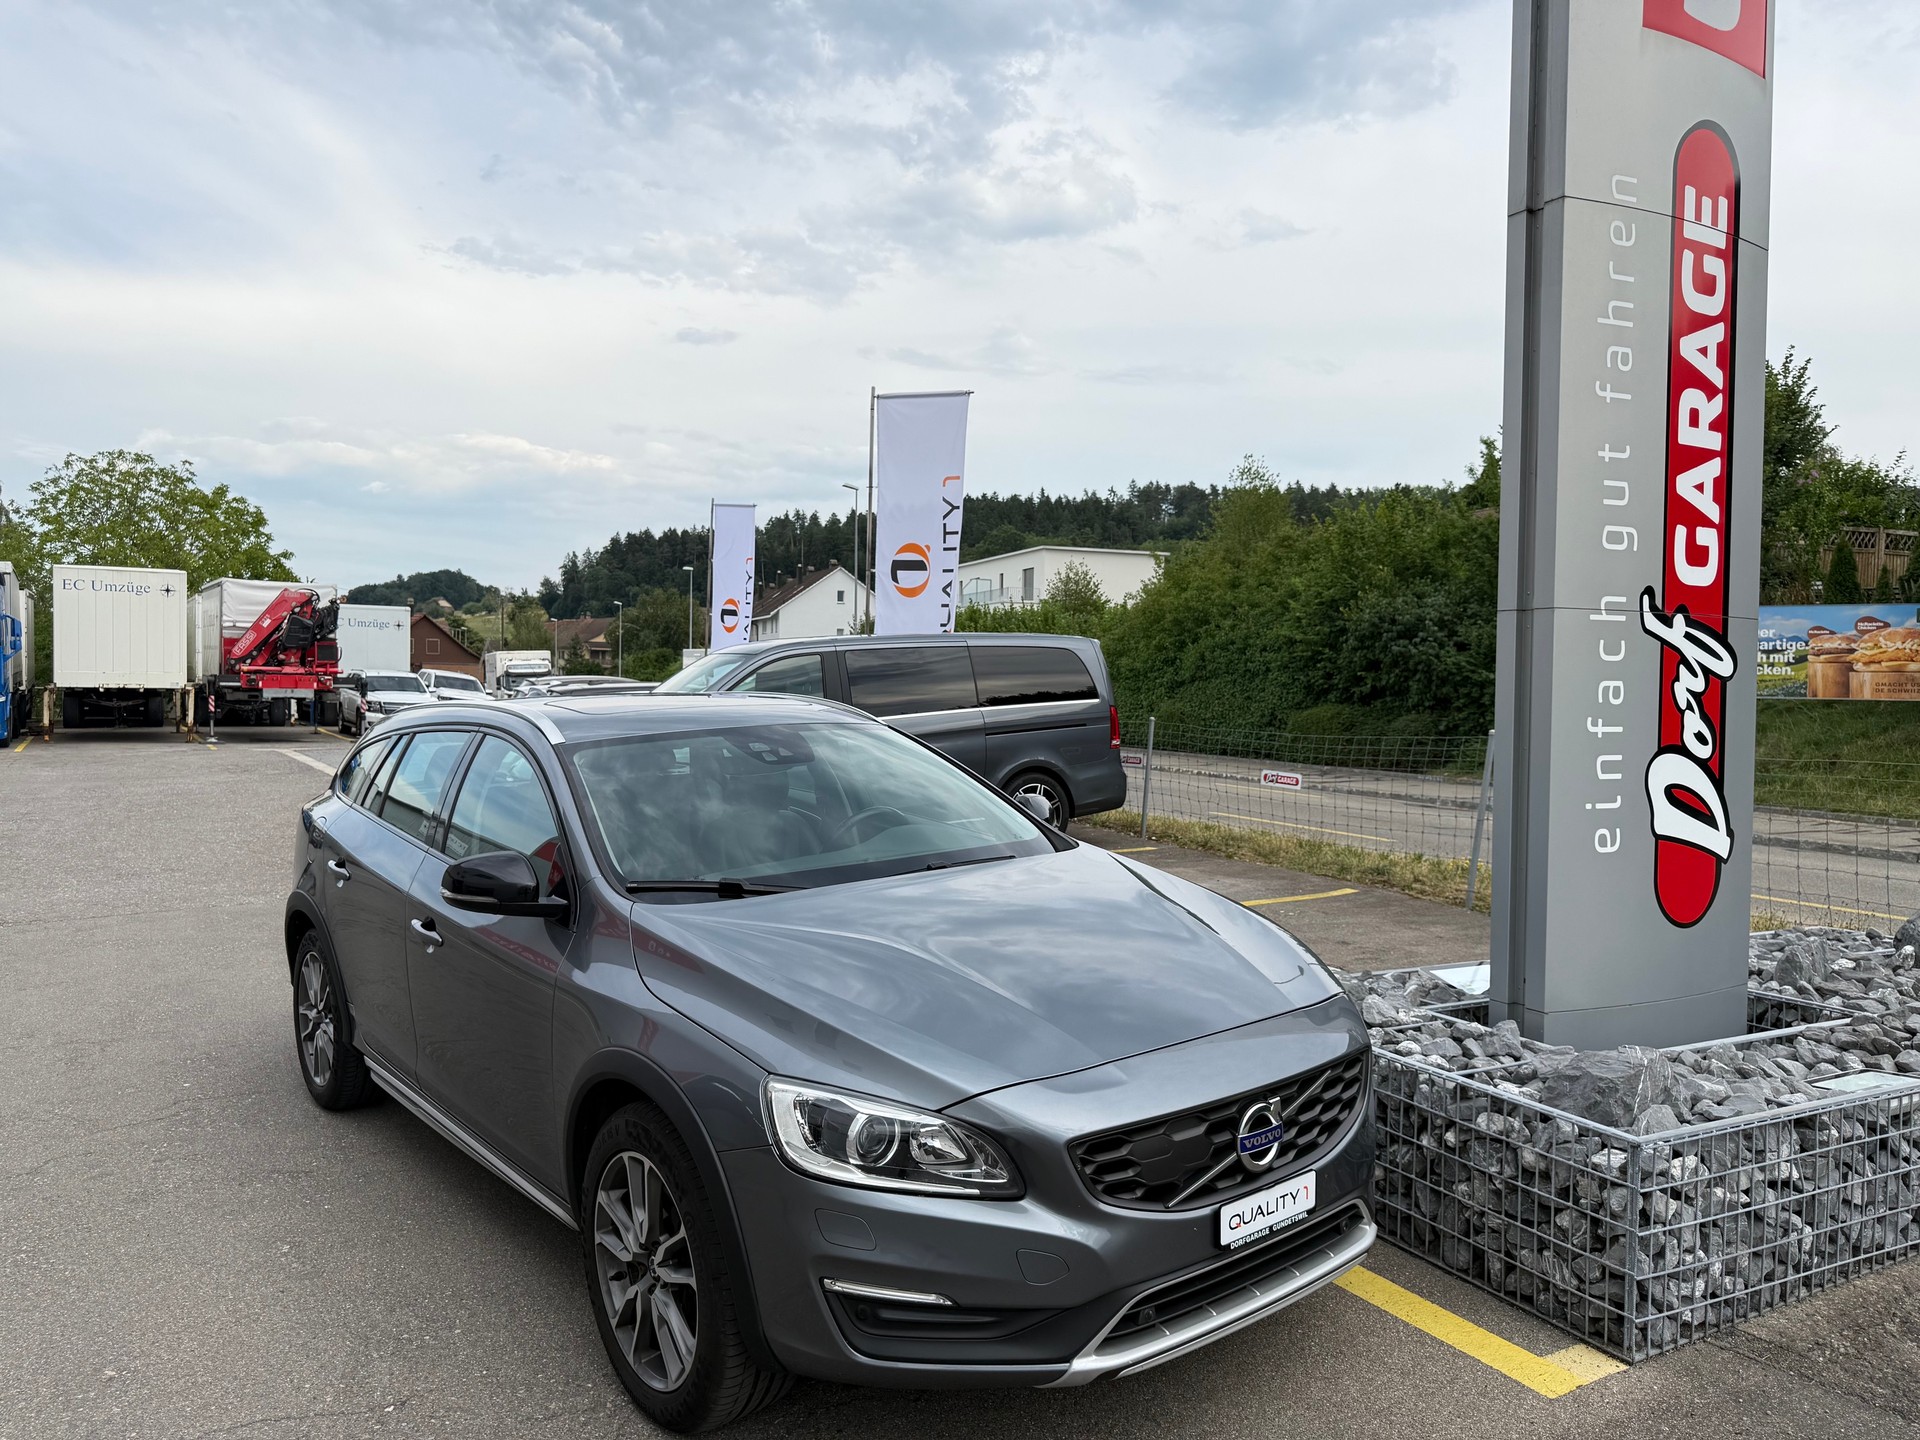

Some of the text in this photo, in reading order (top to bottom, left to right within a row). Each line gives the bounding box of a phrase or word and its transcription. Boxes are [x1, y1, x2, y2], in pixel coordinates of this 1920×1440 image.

[1585, 174, 1638, 854] einfach gut fahren
[1641, 185, 1737, 863] Dorf GARAGE
[62, 578, 151, 596] EC Umzüge
[348, 618, 390, 630] Umzüge
[1757, 629, 1776, 638] er
[1757, 638, 1809, 653] artige.
[1769, 651, 1795, 662] mit
[1756, 664, 1795, 675] cken.
[1242, 1128, 1281, 1148] VOLVO
[1230, 1211, 1309, 1250] DORFGARAGE GUNDETSWIL
